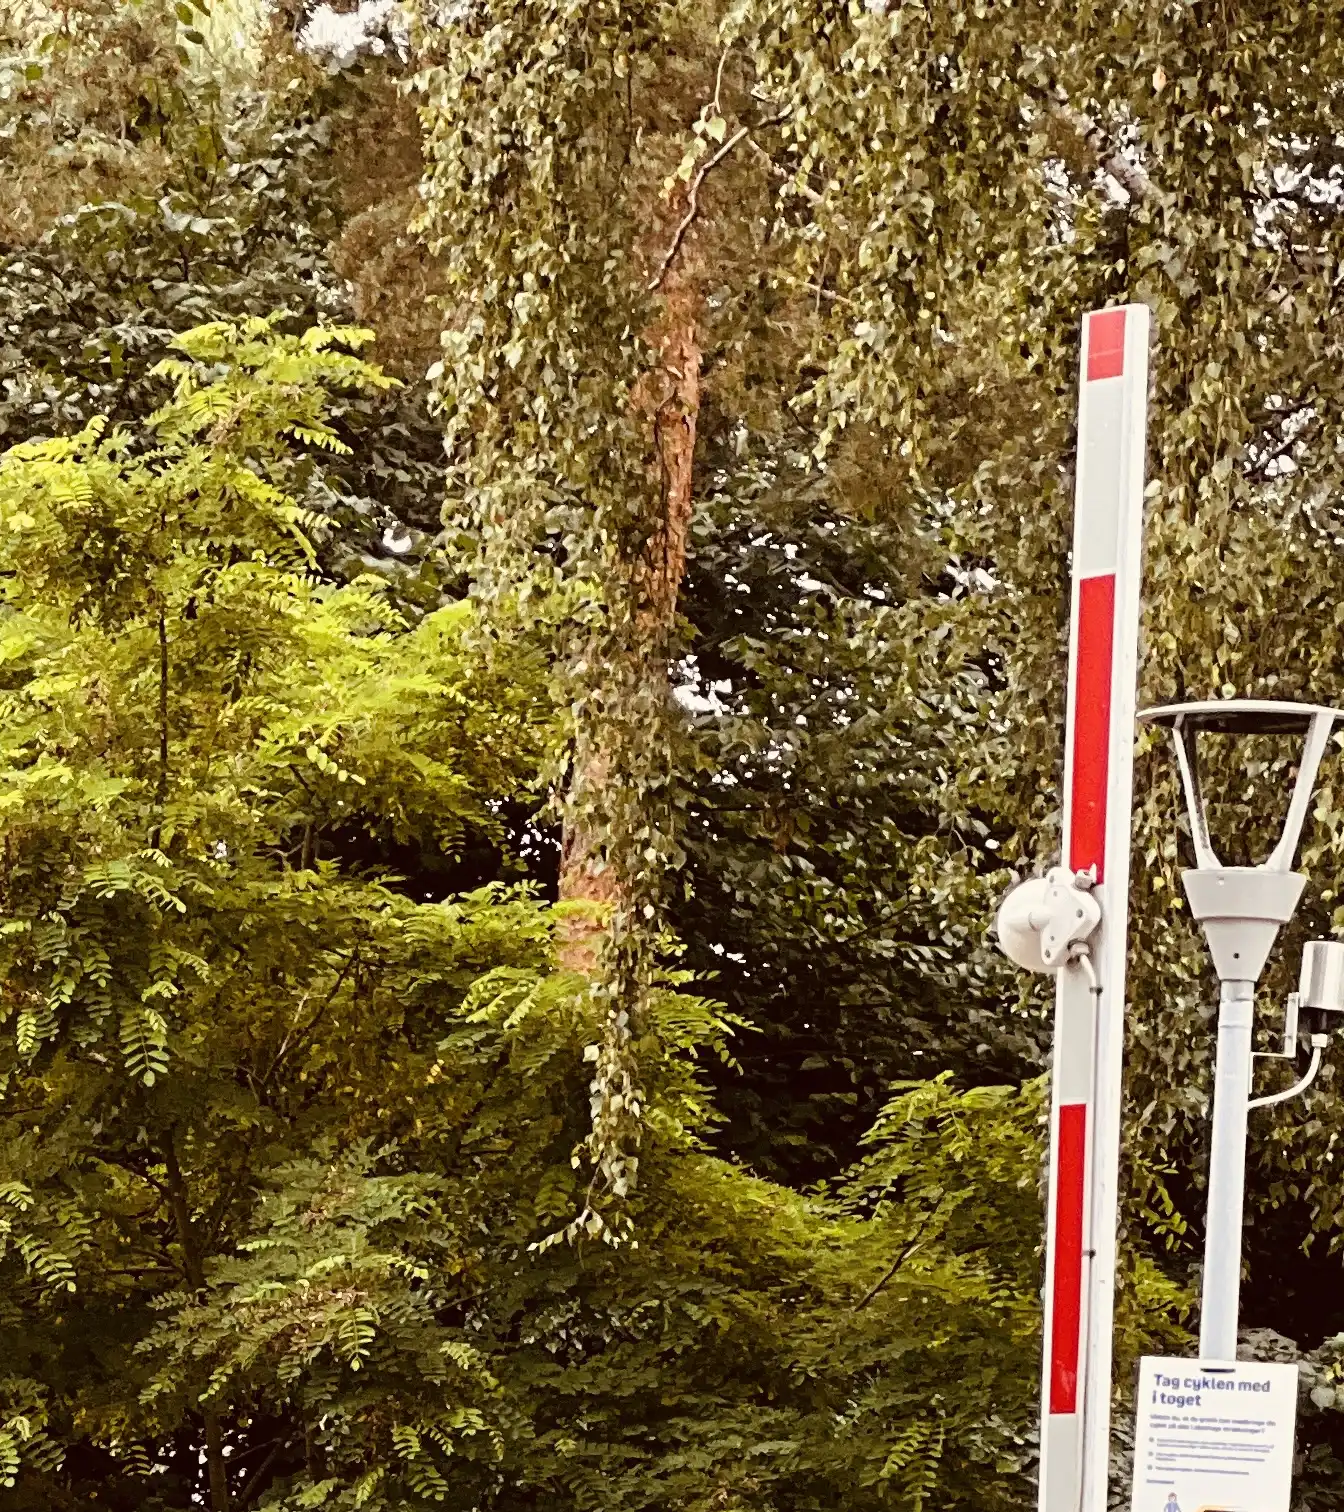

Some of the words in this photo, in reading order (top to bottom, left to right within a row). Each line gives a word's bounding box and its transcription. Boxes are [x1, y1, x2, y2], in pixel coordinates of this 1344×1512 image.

[1154, 1374, 1180, 1390] Tag
[1184, 1376, 1234, 1392] cyklen
[1238, 1380, 1271, 1392] med
[1160, 1392, 1201, 1408] toget
